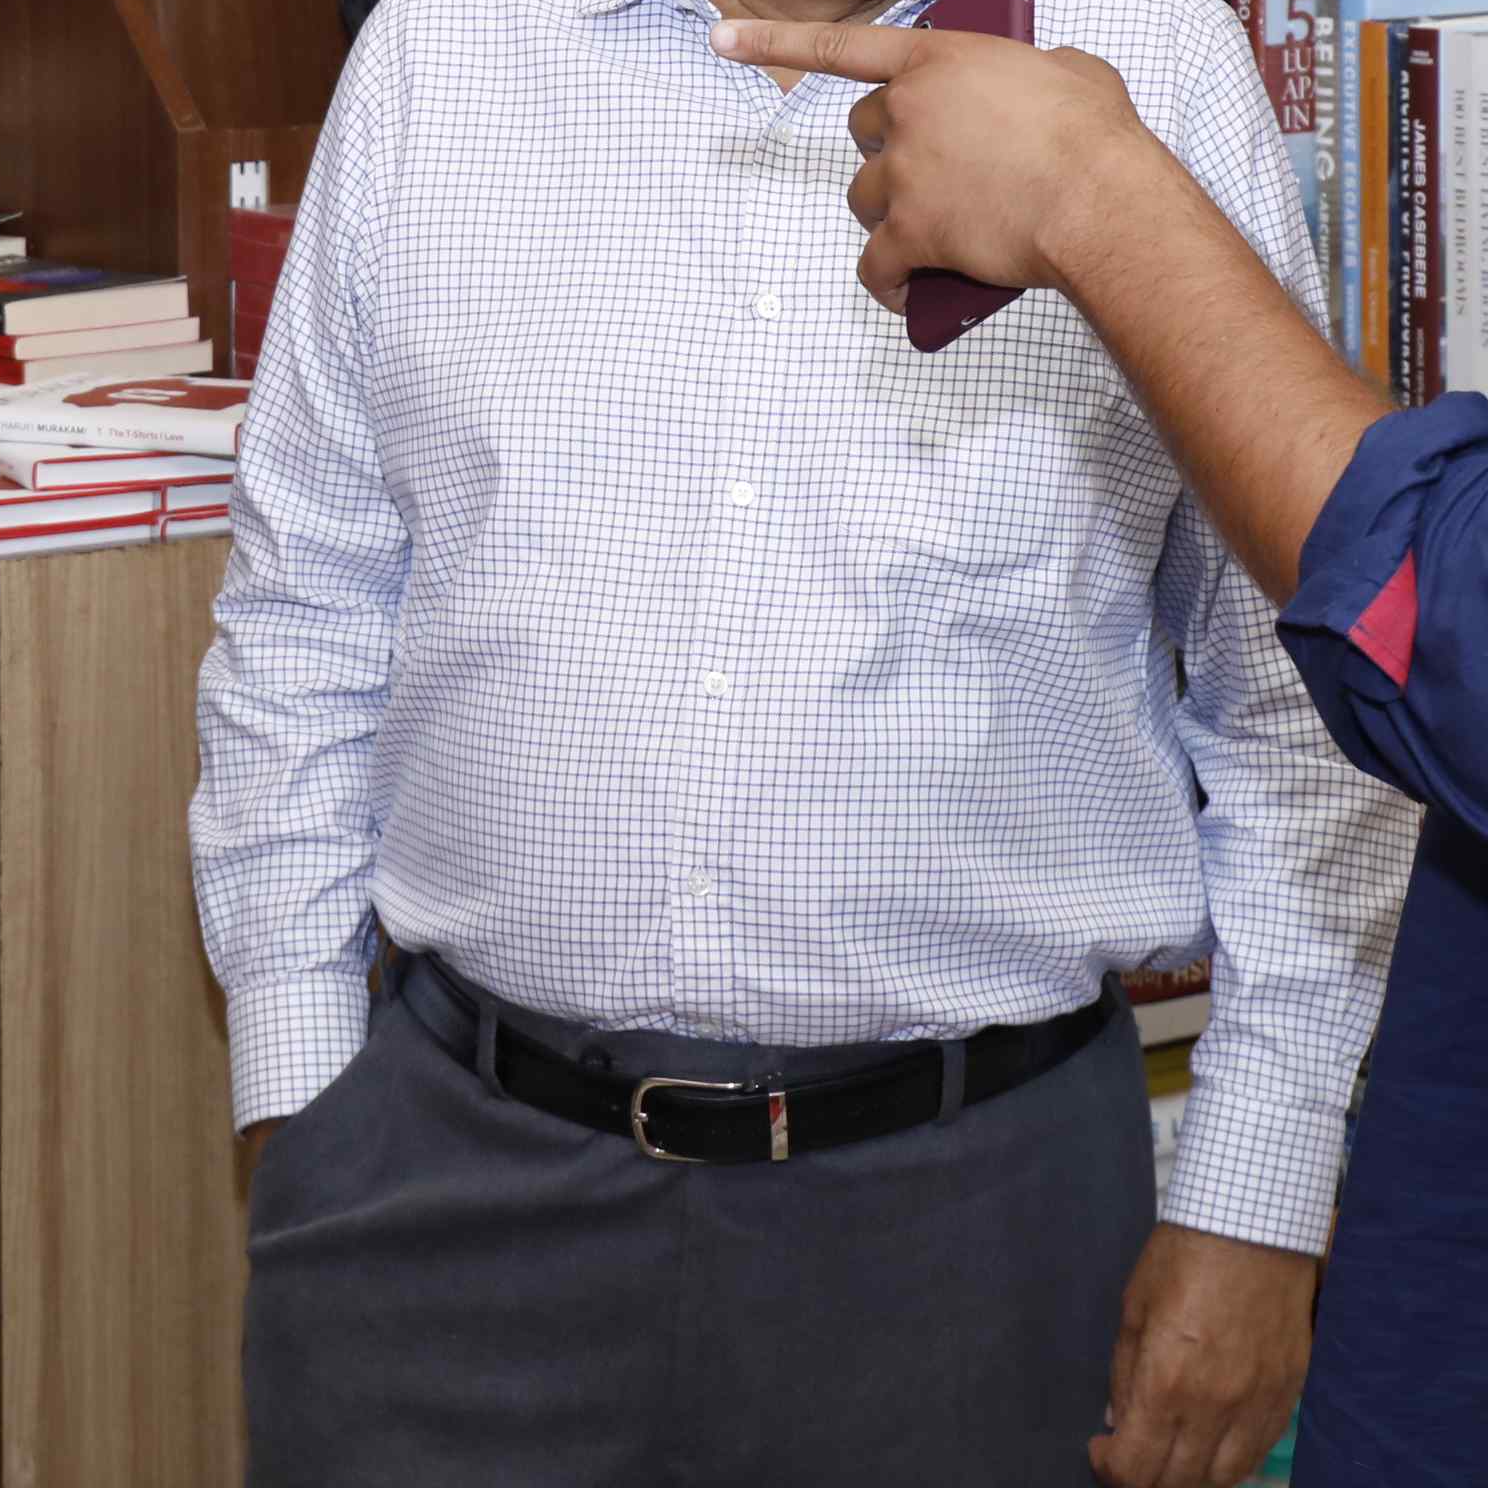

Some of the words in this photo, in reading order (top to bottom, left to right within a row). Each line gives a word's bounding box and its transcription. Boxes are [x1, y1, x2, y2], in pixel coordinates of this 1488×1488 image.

[1315, 16, 1336, 182] BEIJING
[1454, 125, 1467, 178] BEST
[1413, 119, 1427, 187] JAMES
[1343, 161, 1358, 268] ESCAPES
[1413, 191, 1427, 299] CASEBERE
[1454, 188, 1467, 317] BEDROOMS
[0, 420, 36, 434] HARUKI
[36, 423, 89, 435] MURAKAMI
